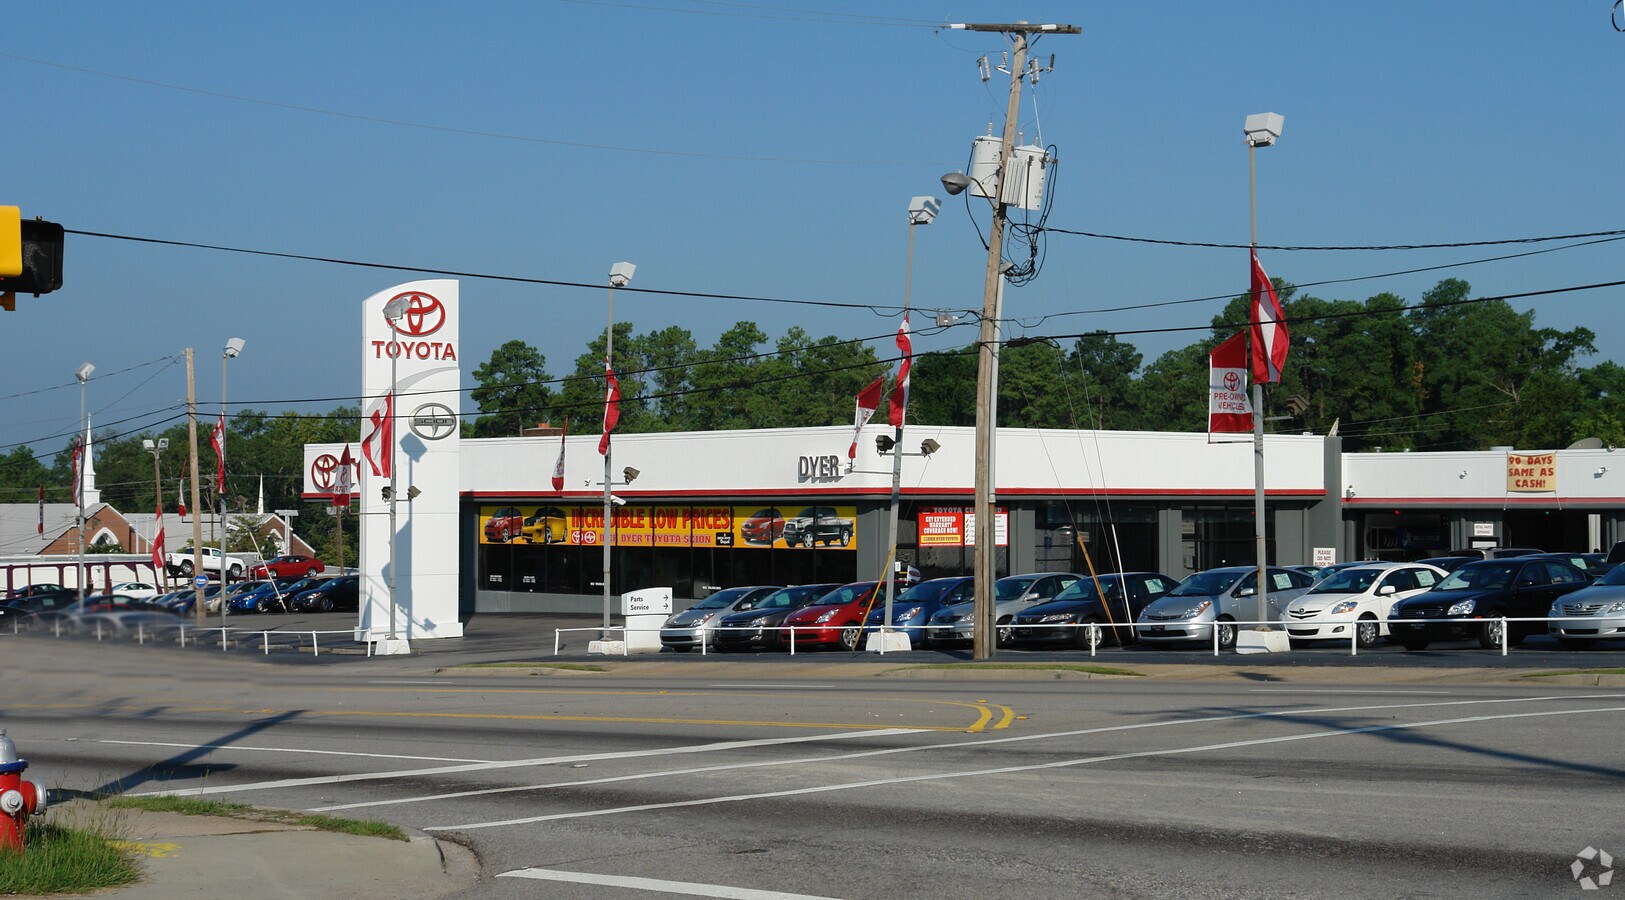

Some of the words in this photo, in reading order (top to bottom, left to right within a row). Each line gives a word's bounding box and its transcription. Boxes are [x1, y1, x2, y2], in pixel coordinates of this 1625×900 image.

[371, 340, 457, 361] TOYOTA
[1508, 456, 1521, 465] 90
[1527, 456, 1553, 465] DAYS
[799, 455, 840, 477] DYER
[1508, 468, 1534, 477] SAME
[1540, 468, 1554, 477] AS
[1515, 479, 1546, 488] CASH!
[649, 508, 679, 529] LOW
[682, 508, 735, 529] PRICES!
[621, 534, 643, 543] DYER
